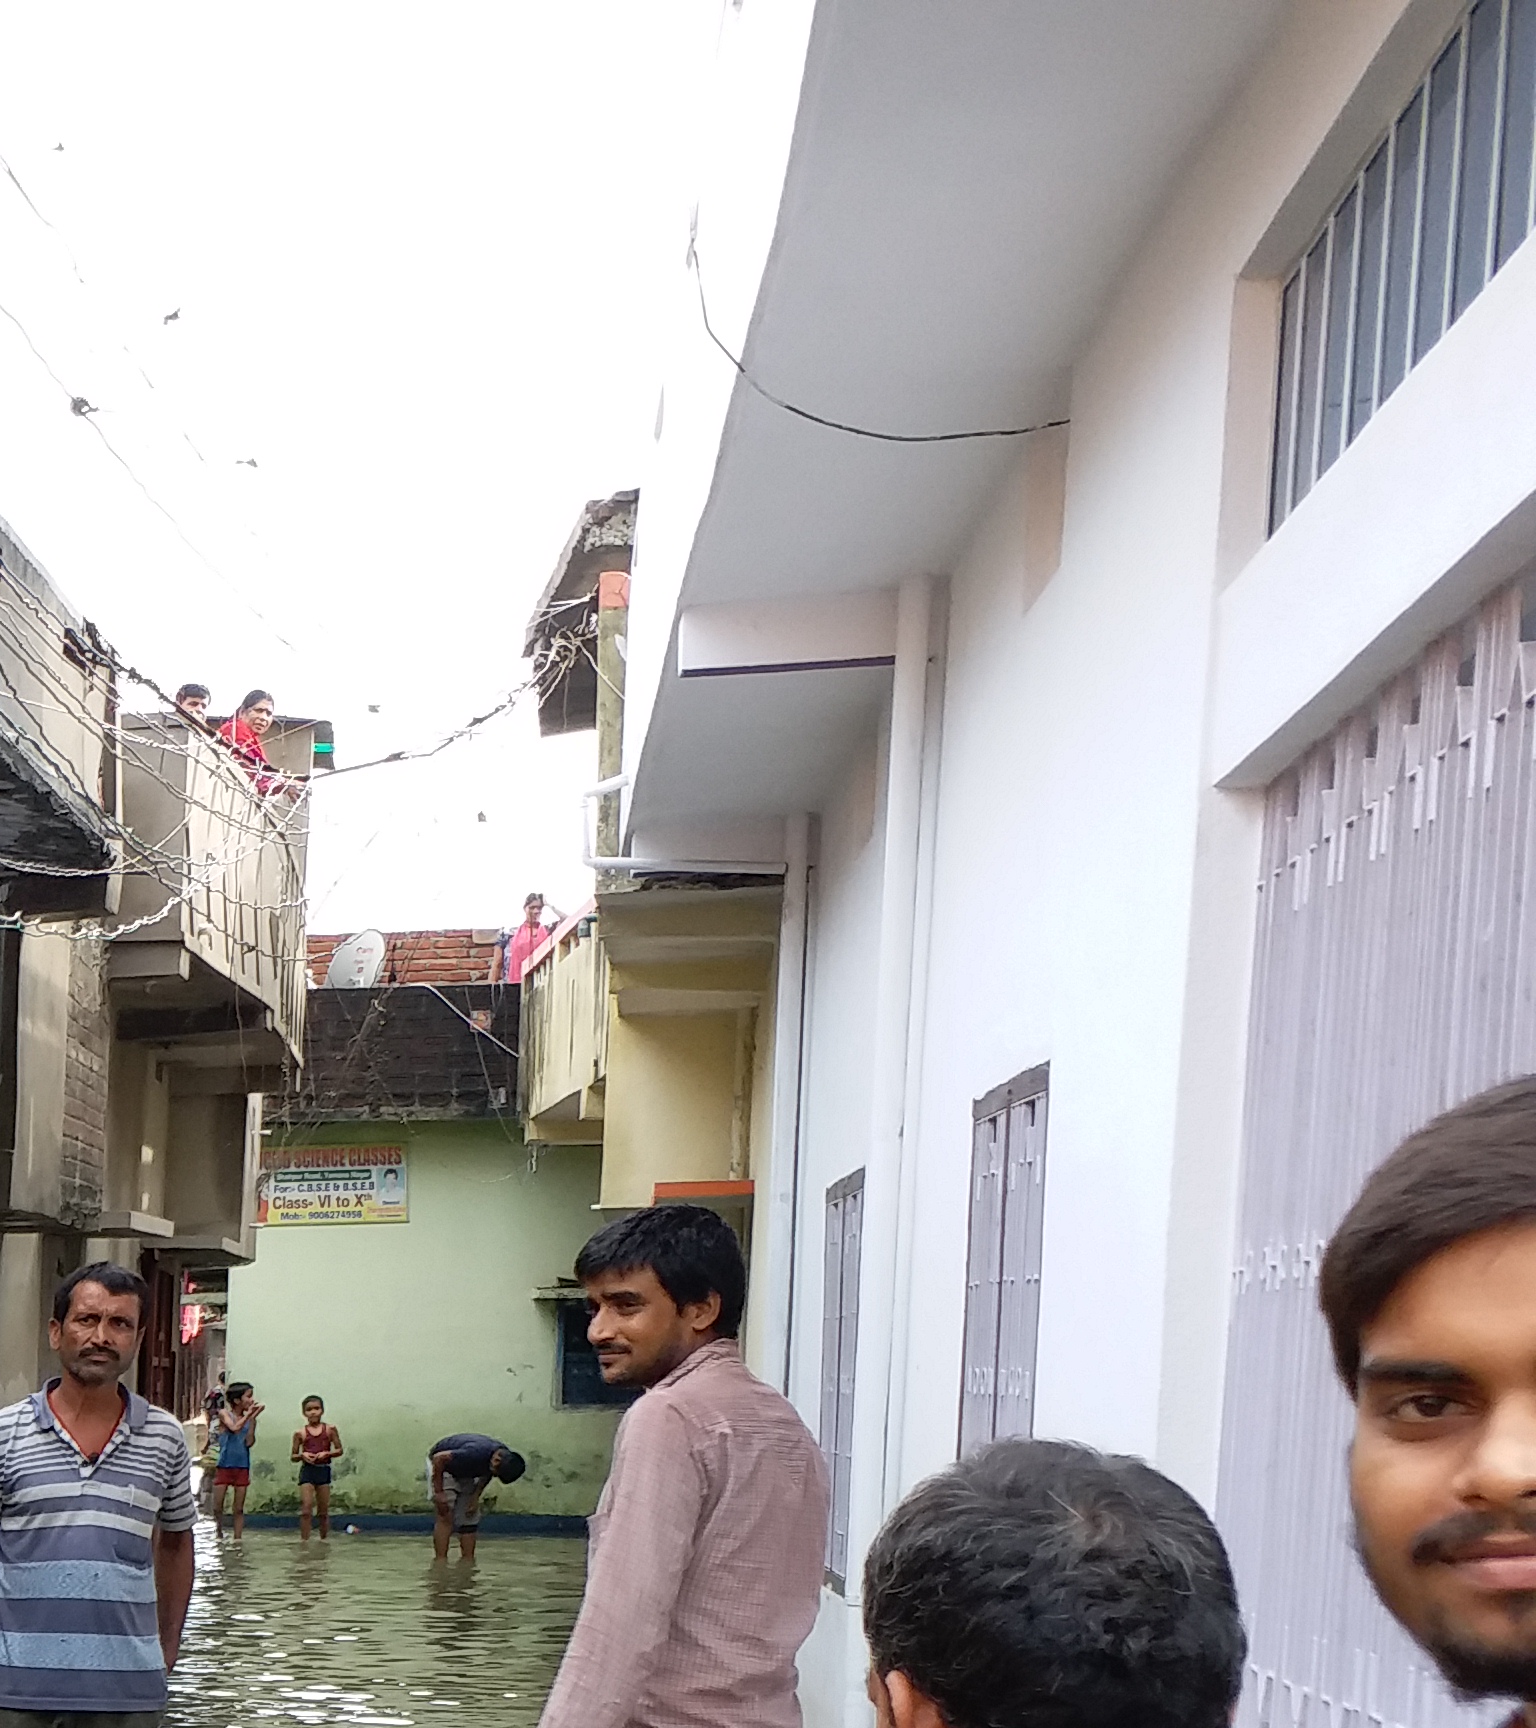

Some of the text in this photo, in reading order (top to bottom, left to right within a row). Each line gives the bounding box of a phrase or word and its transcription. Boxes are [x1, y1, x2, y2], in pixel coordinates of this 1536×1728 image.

[294, 1148, 345, 1168] SCIENCE
[349, 1146, 402, 1167] CLASSES
[333, 1182, 340, 1191] &
[317, 1194, 331, 1208] VI
[336, 1195, 350, 1208] to
